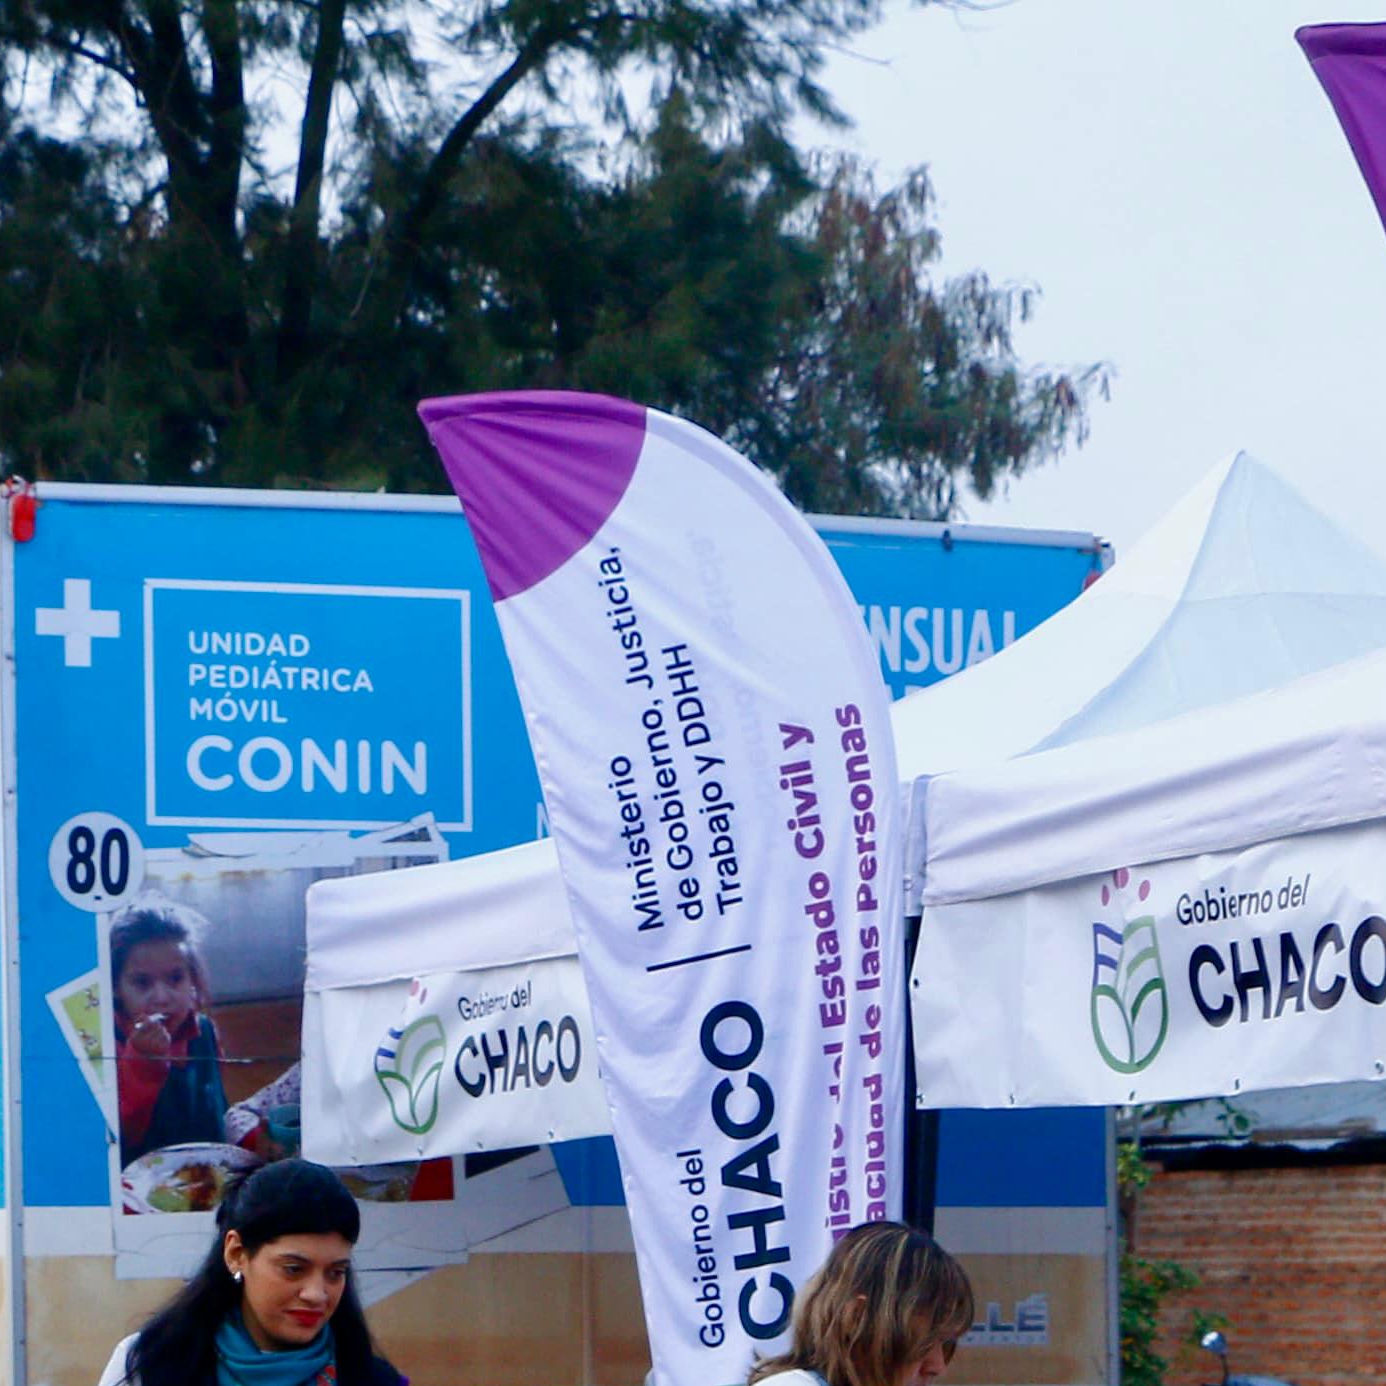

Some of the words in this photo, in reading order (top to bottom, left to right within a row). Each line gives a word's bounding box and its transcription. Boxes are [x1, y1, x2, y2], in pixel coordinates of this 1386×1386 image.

[188, 631, 311, 658] UNIDAD
[598, 547, 654, 690] Justicia,
[858, 604, 1015, 675] NSUA
[188, 660, 374, 693] PEDIÁTRICA
[188, 694, 288, 724] MÓVIL
[662, 643, 711, 748] DDHH
[186, 735, 428, 796] CONIN
[700, 754, 725, 778] y
[778, 722, 815, 748] y
[641, 699, 695, 870] Gobierno,
[780, 760, 825, 860] Civil
[835, 704, 880, 912] Personas
[67, 825, 129, 896] 80
[608, 756, 665, 932] Ministerio
[700, 780, 744, 917] Trabajo
[677, 875, 703, 922] de
[1175, 883, 1274, 927] Gobierno
[1277, 873, 1310, 913] del
[805, 872, 847, 1029] Estado
[856, 922, 881, 992] las
[510, 980, 532, 1009] del
[454, 1015, 581, 1098] CHACO
[859, 1004, 883, 1059] de
[677, 1148, 705, 1197] del
[699, 999, 796, 1341] CHACO
[863, 1073, 887, 1222] acidad
[690, 1203, 725, 1350] Gobierno
